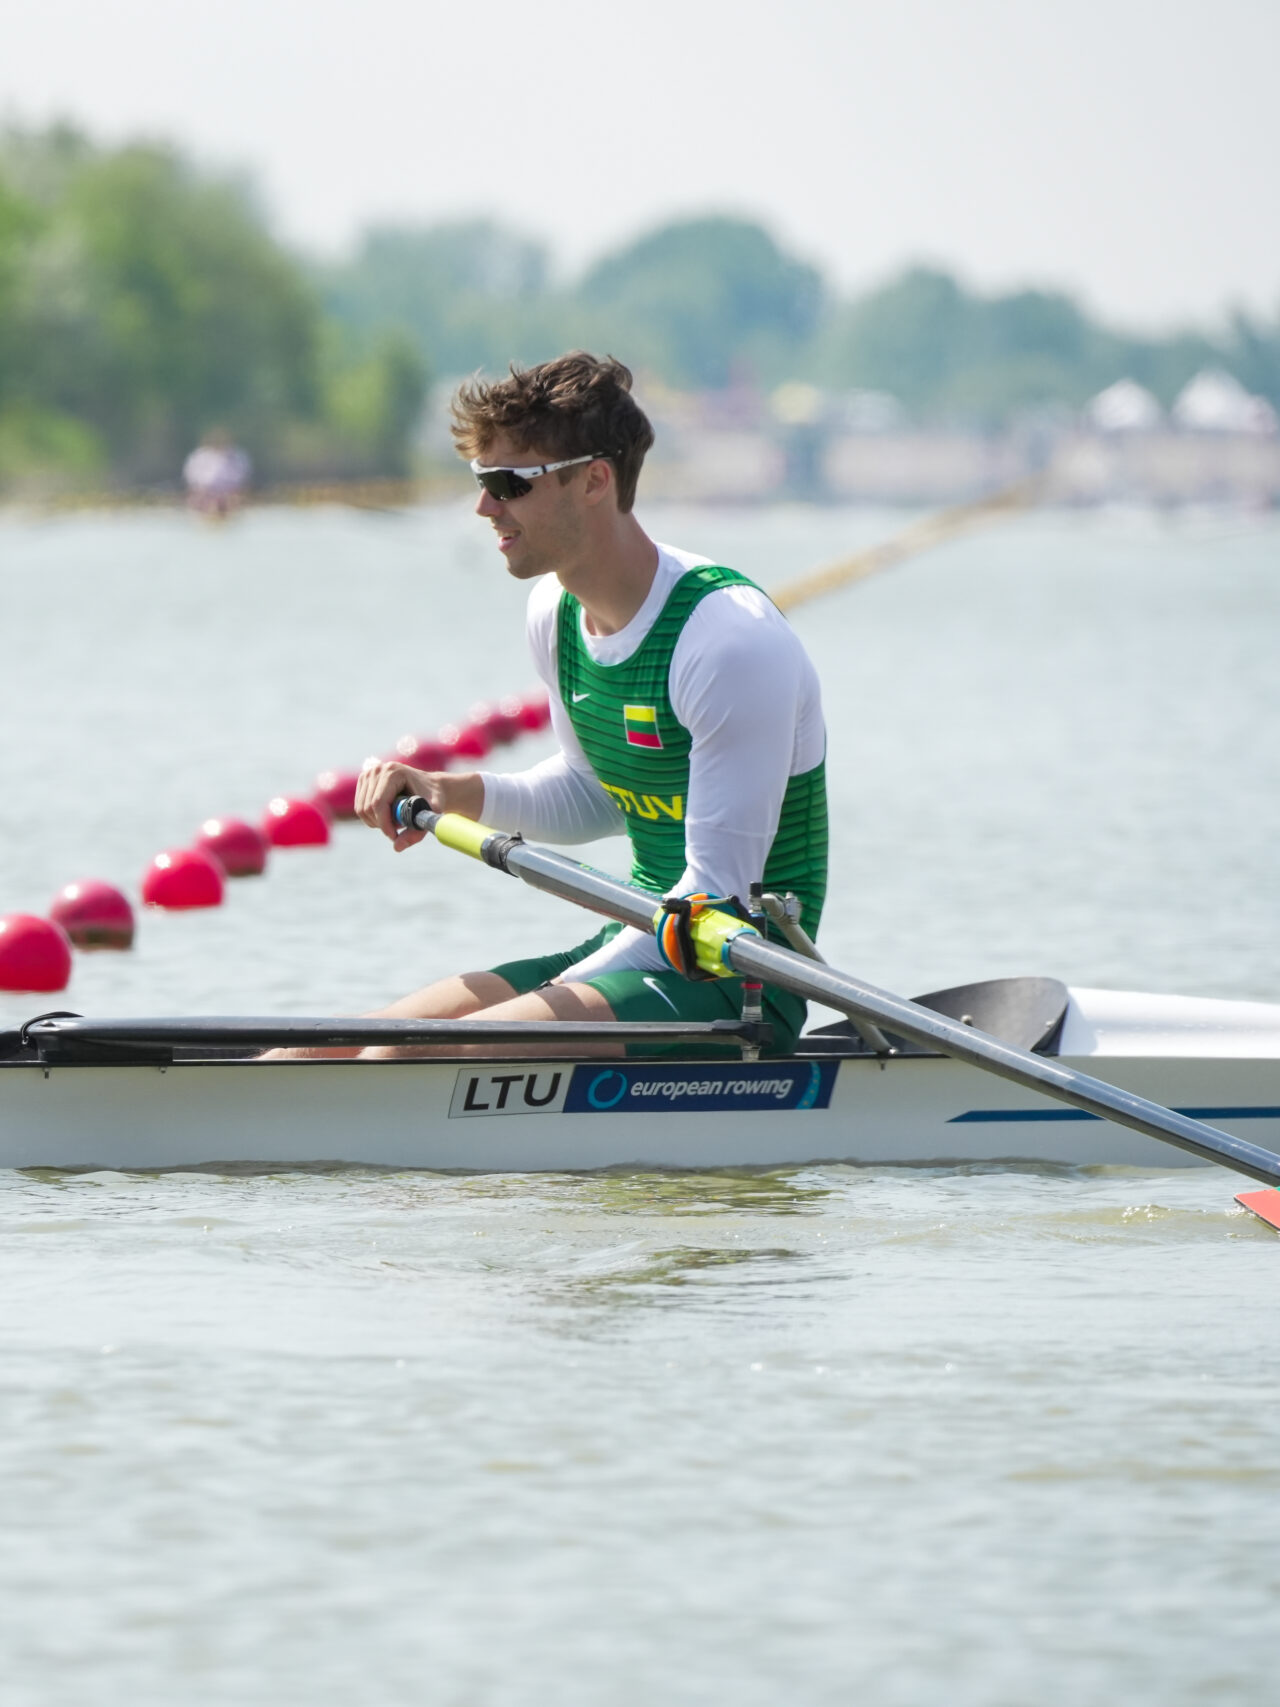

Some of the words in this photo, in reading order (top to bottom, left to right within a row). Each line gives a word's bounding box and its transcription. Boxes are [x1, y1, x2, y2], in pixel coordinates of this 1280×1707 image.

[600, 780, 683, 820] TUV
[463, 1072, 562, 1111] LTU
[630, 1080, 720, 1100] european
[724, 1078, 794, 1099] rowing
